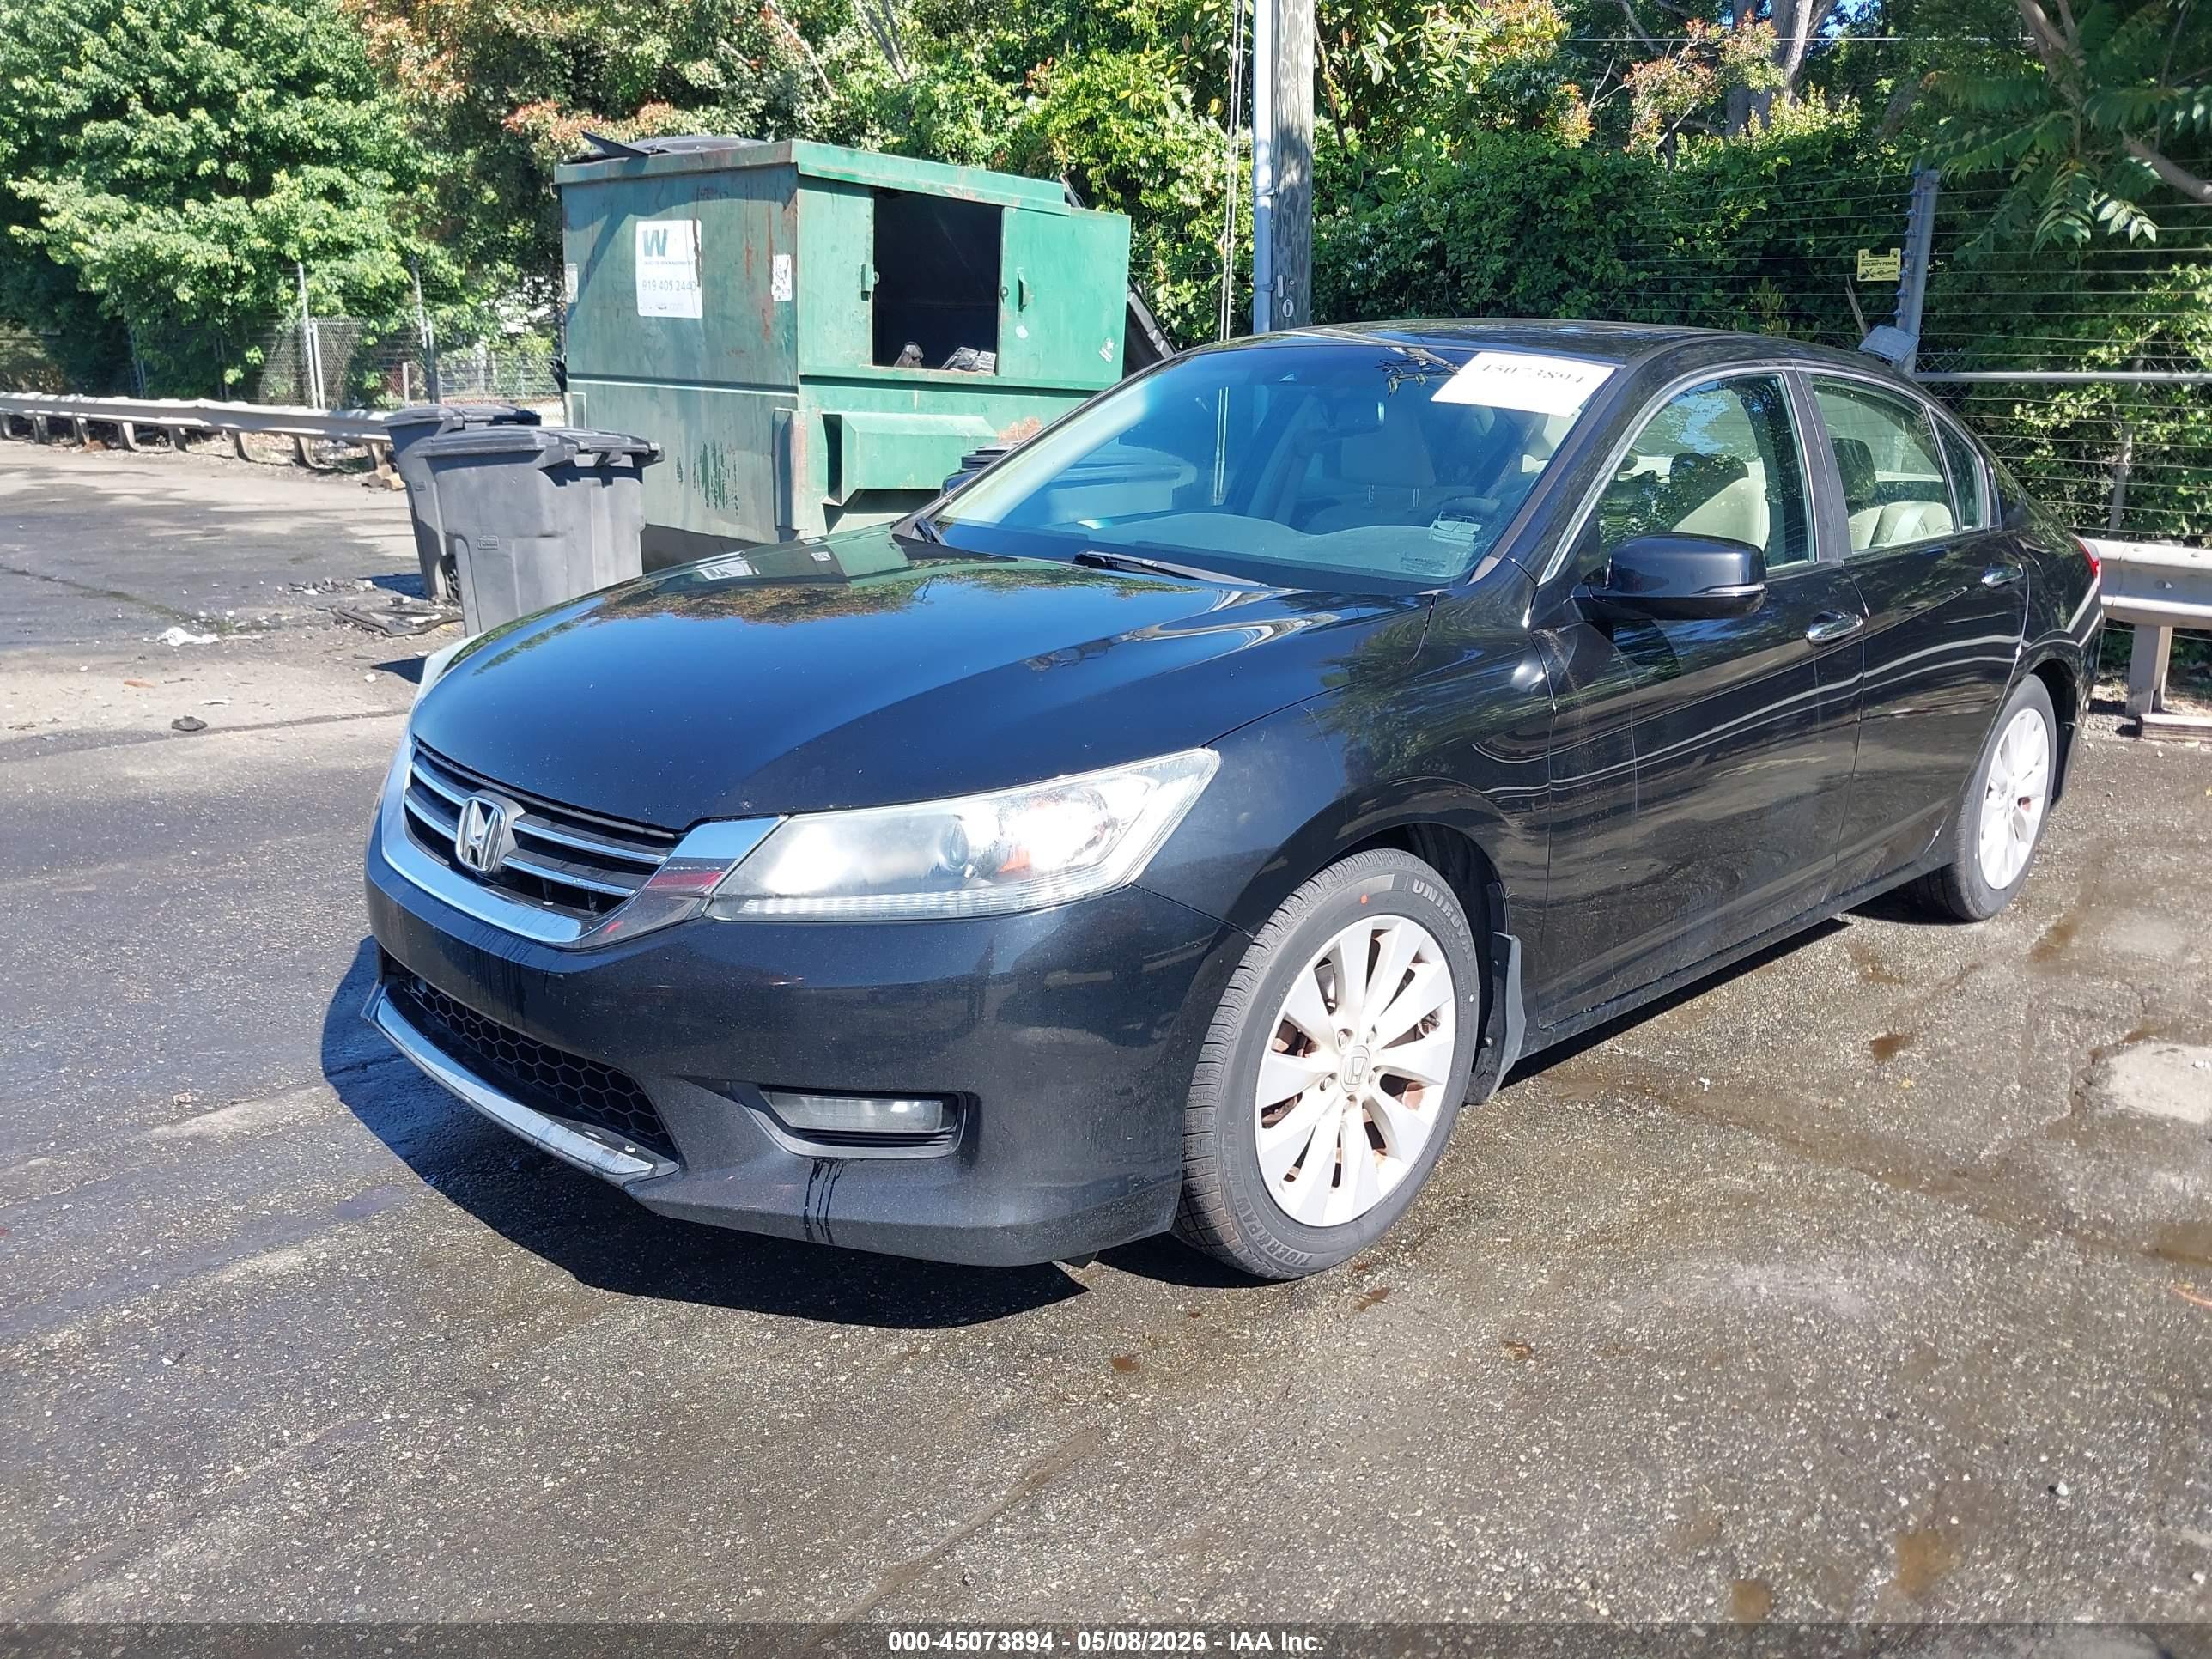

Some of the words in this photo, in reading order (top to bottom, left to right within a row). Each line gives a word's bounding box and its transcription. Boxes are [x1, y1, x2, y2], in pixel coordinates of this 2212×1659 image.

[1412, 878, 1474, 968] UNIROYAL
[1236, 1196, 1262, 1235] PAW
[1266, 1243, 1313, 1267] TIGER
